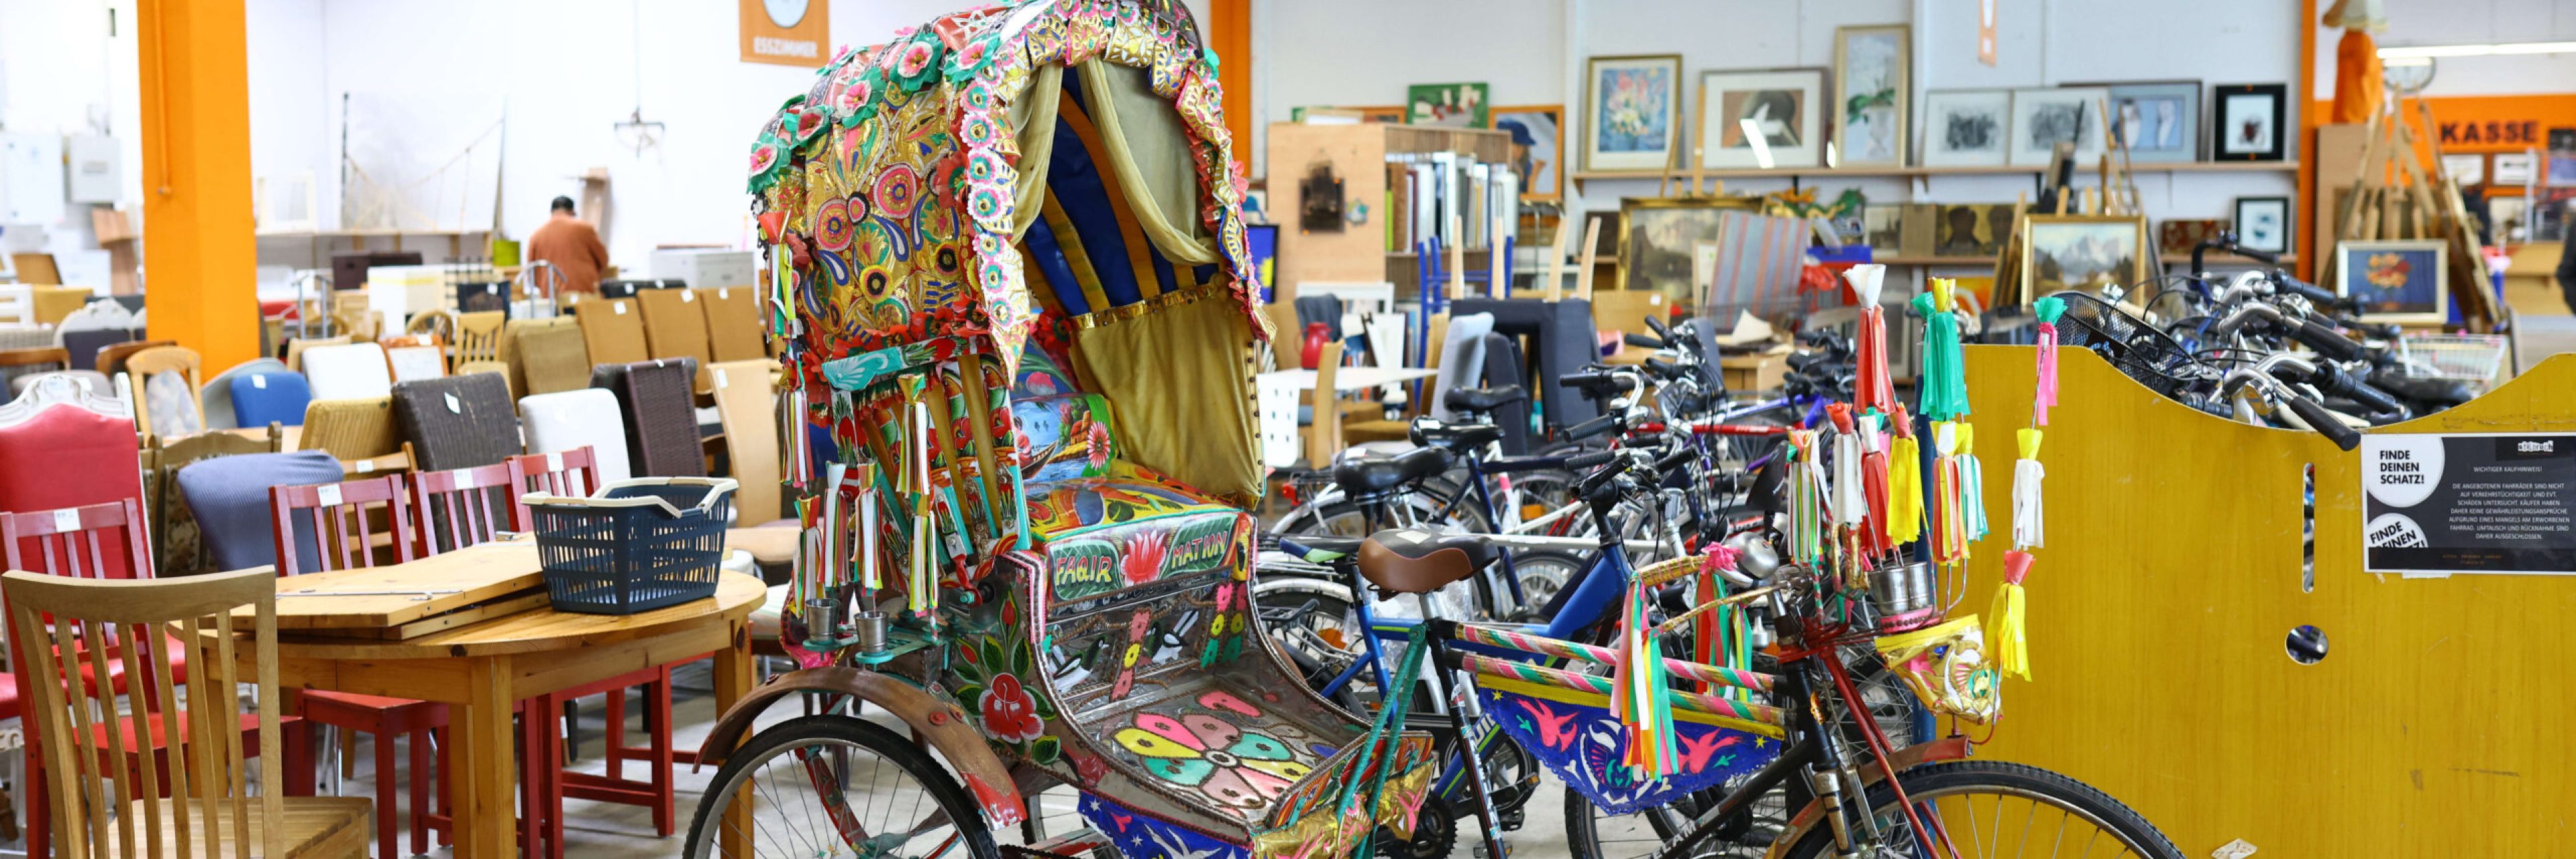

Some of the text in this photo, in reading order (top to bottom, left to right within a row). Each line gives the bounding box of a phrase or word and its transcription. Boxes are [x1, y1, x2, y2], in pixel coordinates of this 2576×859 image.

[2440, 120, 2538, 144] KASSE
[2379, 450, 2410, 460] FINDE
[2380, 462, 2420, 472] DEINEN
[2380, 474, 2424, 484] SCHATZ!
[2369, 521, 2403, 544] FINDE
[2377, 529, 2417, 548] EINEN
[1055, 556, 1112, 586] FAQIR
